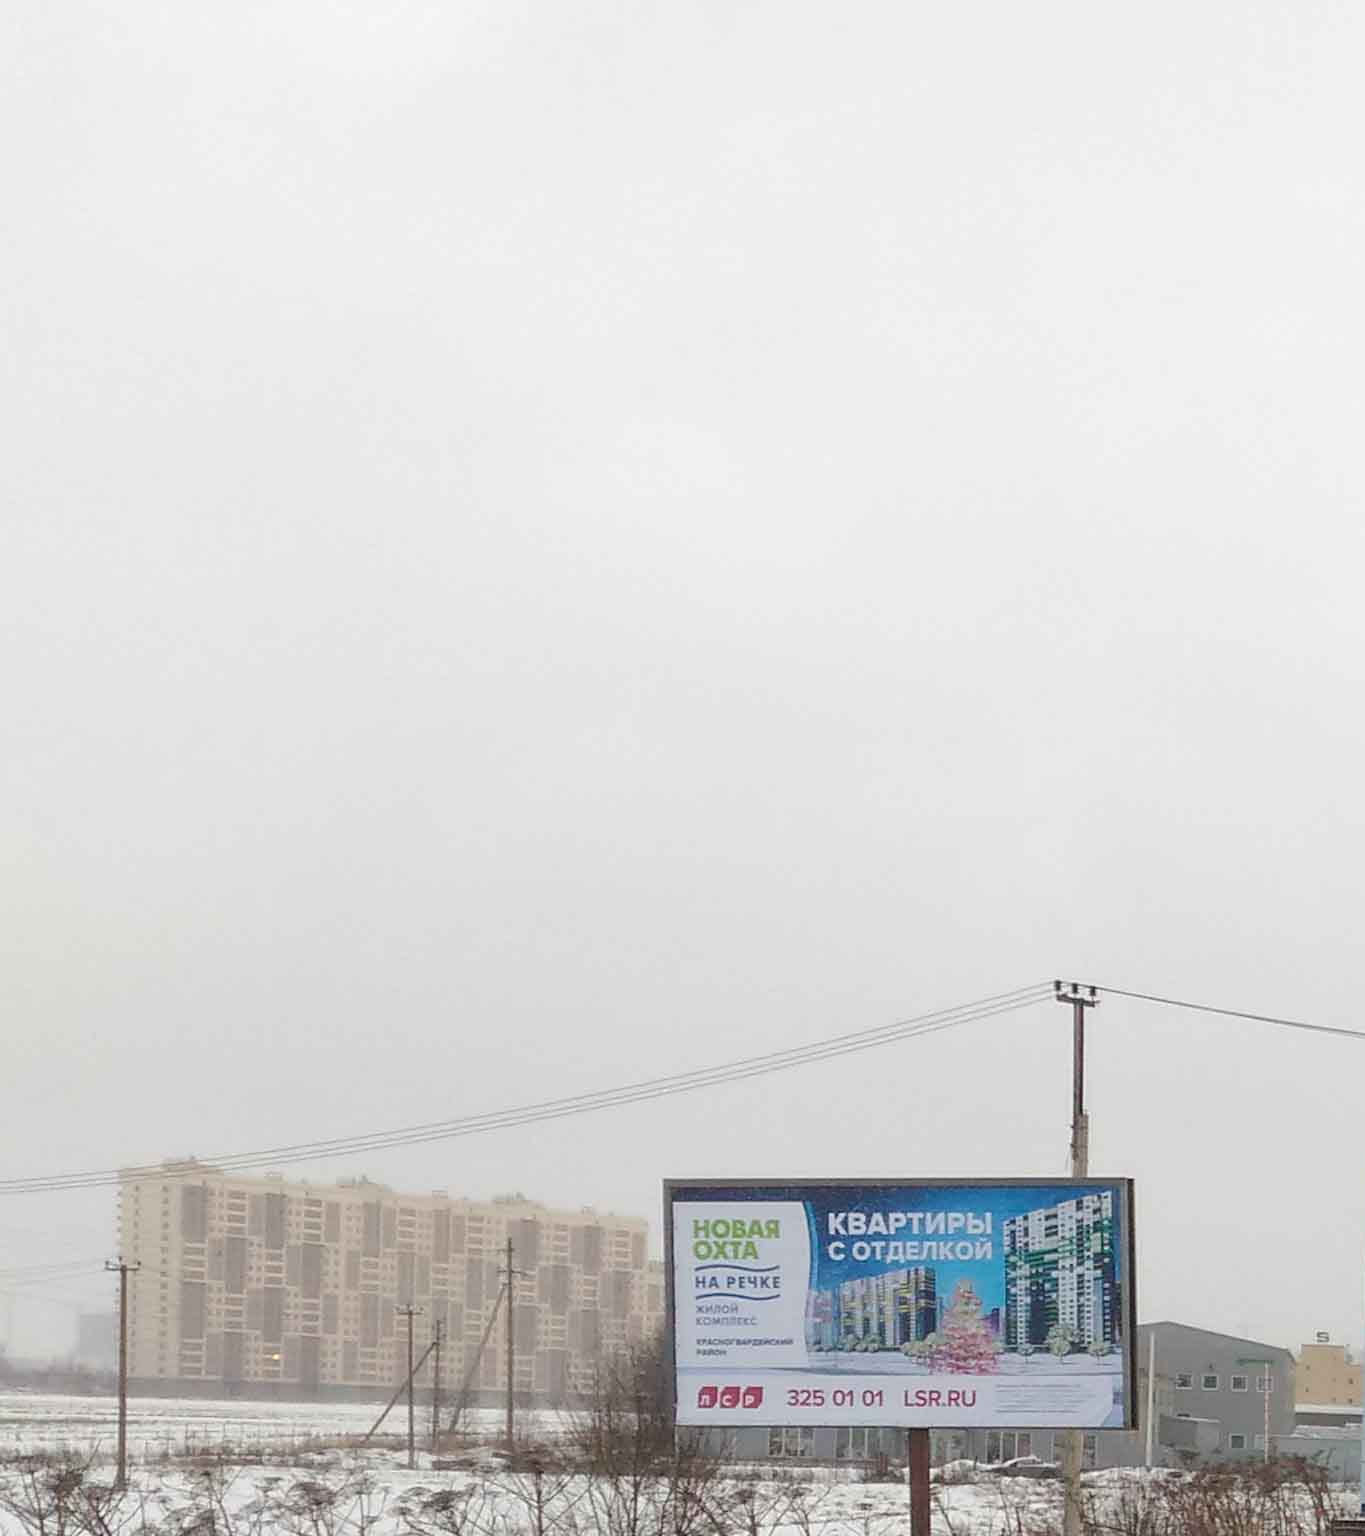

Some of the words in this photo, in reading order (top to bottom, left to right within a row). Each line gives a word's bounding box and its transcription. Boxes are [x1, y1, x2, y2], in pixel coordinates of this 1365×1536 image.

[693, 1219, 780, 1239] НОВАЯ
[828, 1212, 993, 1235] КВАРТИРЫ
[693, 1240, 759, 1260] ОХТА
[828, 1241, 845, 1261] С
[852, 1236, 993, 1263] ОТДЕЛКОЙ
[695, 1276, 720, 1289] НА
[727, 1276, 781, 1289] РЕЧКЕ
[695, 1303, 739, 1314] ЖИЛОЙ
[787, 1389, 825, 1407] 325
[832, 1389, 854, 1407] 01
[862, 1389, 883, 1407] 01
[904, 1389, 977, 1407] LSR.RU
